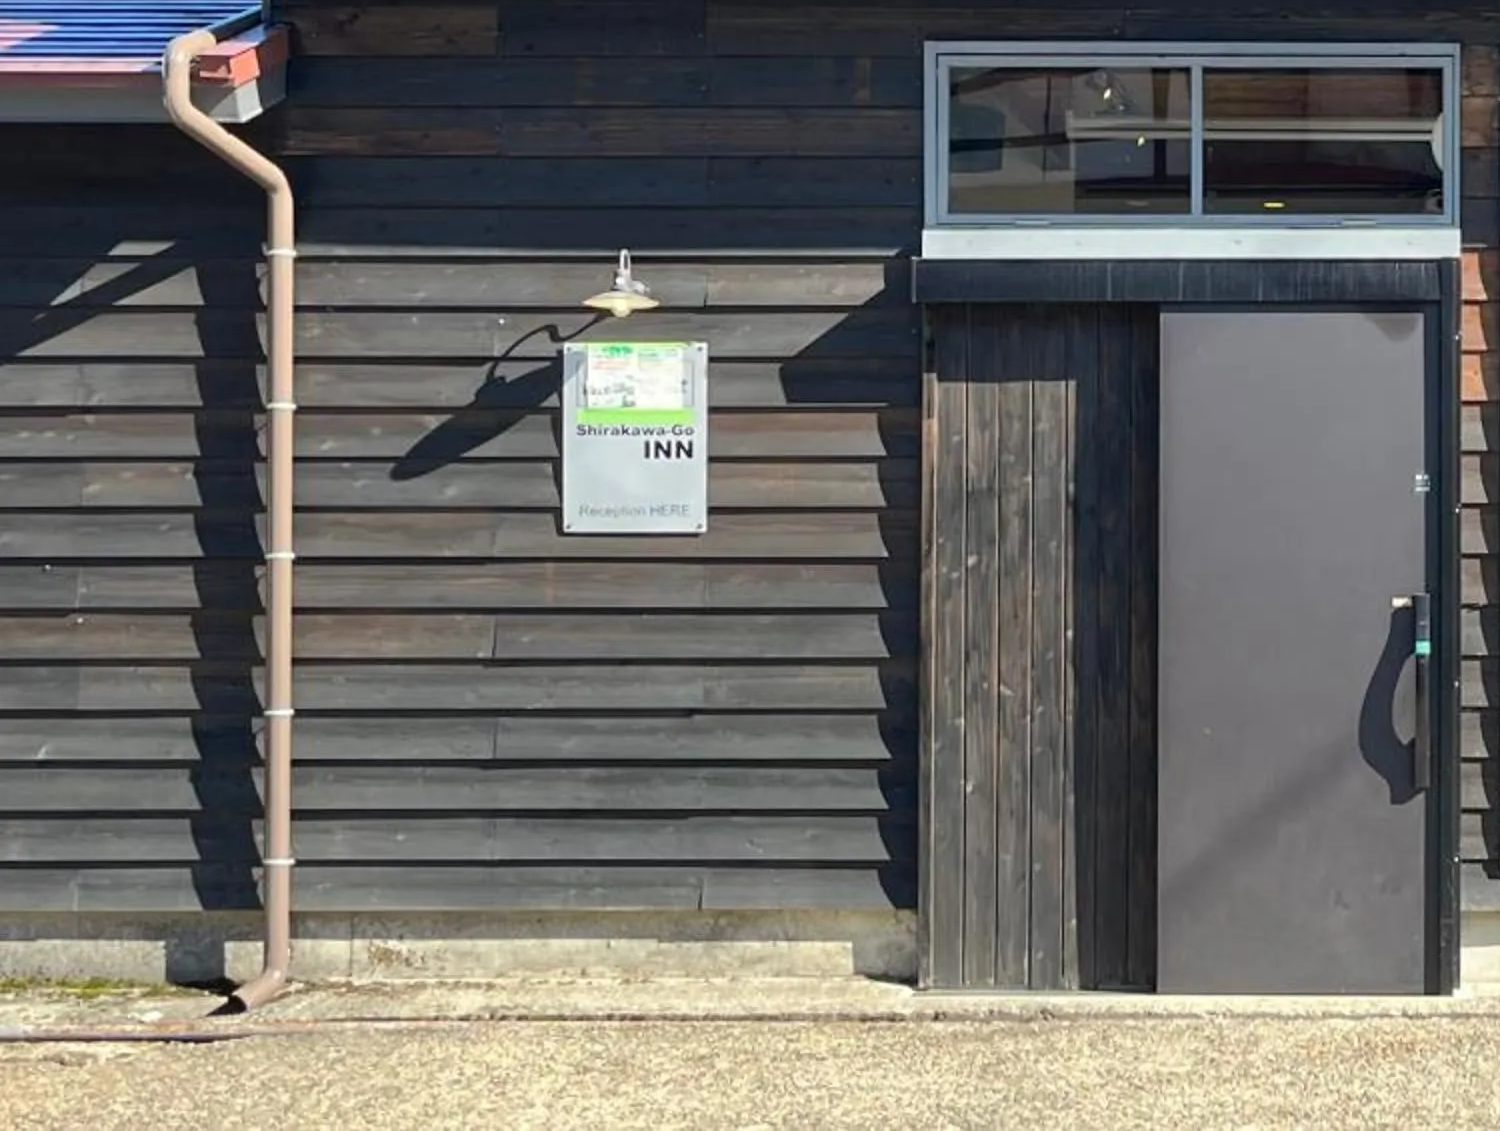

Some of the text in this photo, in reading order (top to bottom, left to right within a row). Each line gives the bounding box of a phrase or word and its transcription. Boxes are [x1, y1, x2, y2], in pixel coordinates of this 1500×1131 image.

[576, 423, 695, 437] Shirakawa-Go
[643, 440, 694, 460] INN
[578, 503, 690, 519] Reception HERE
